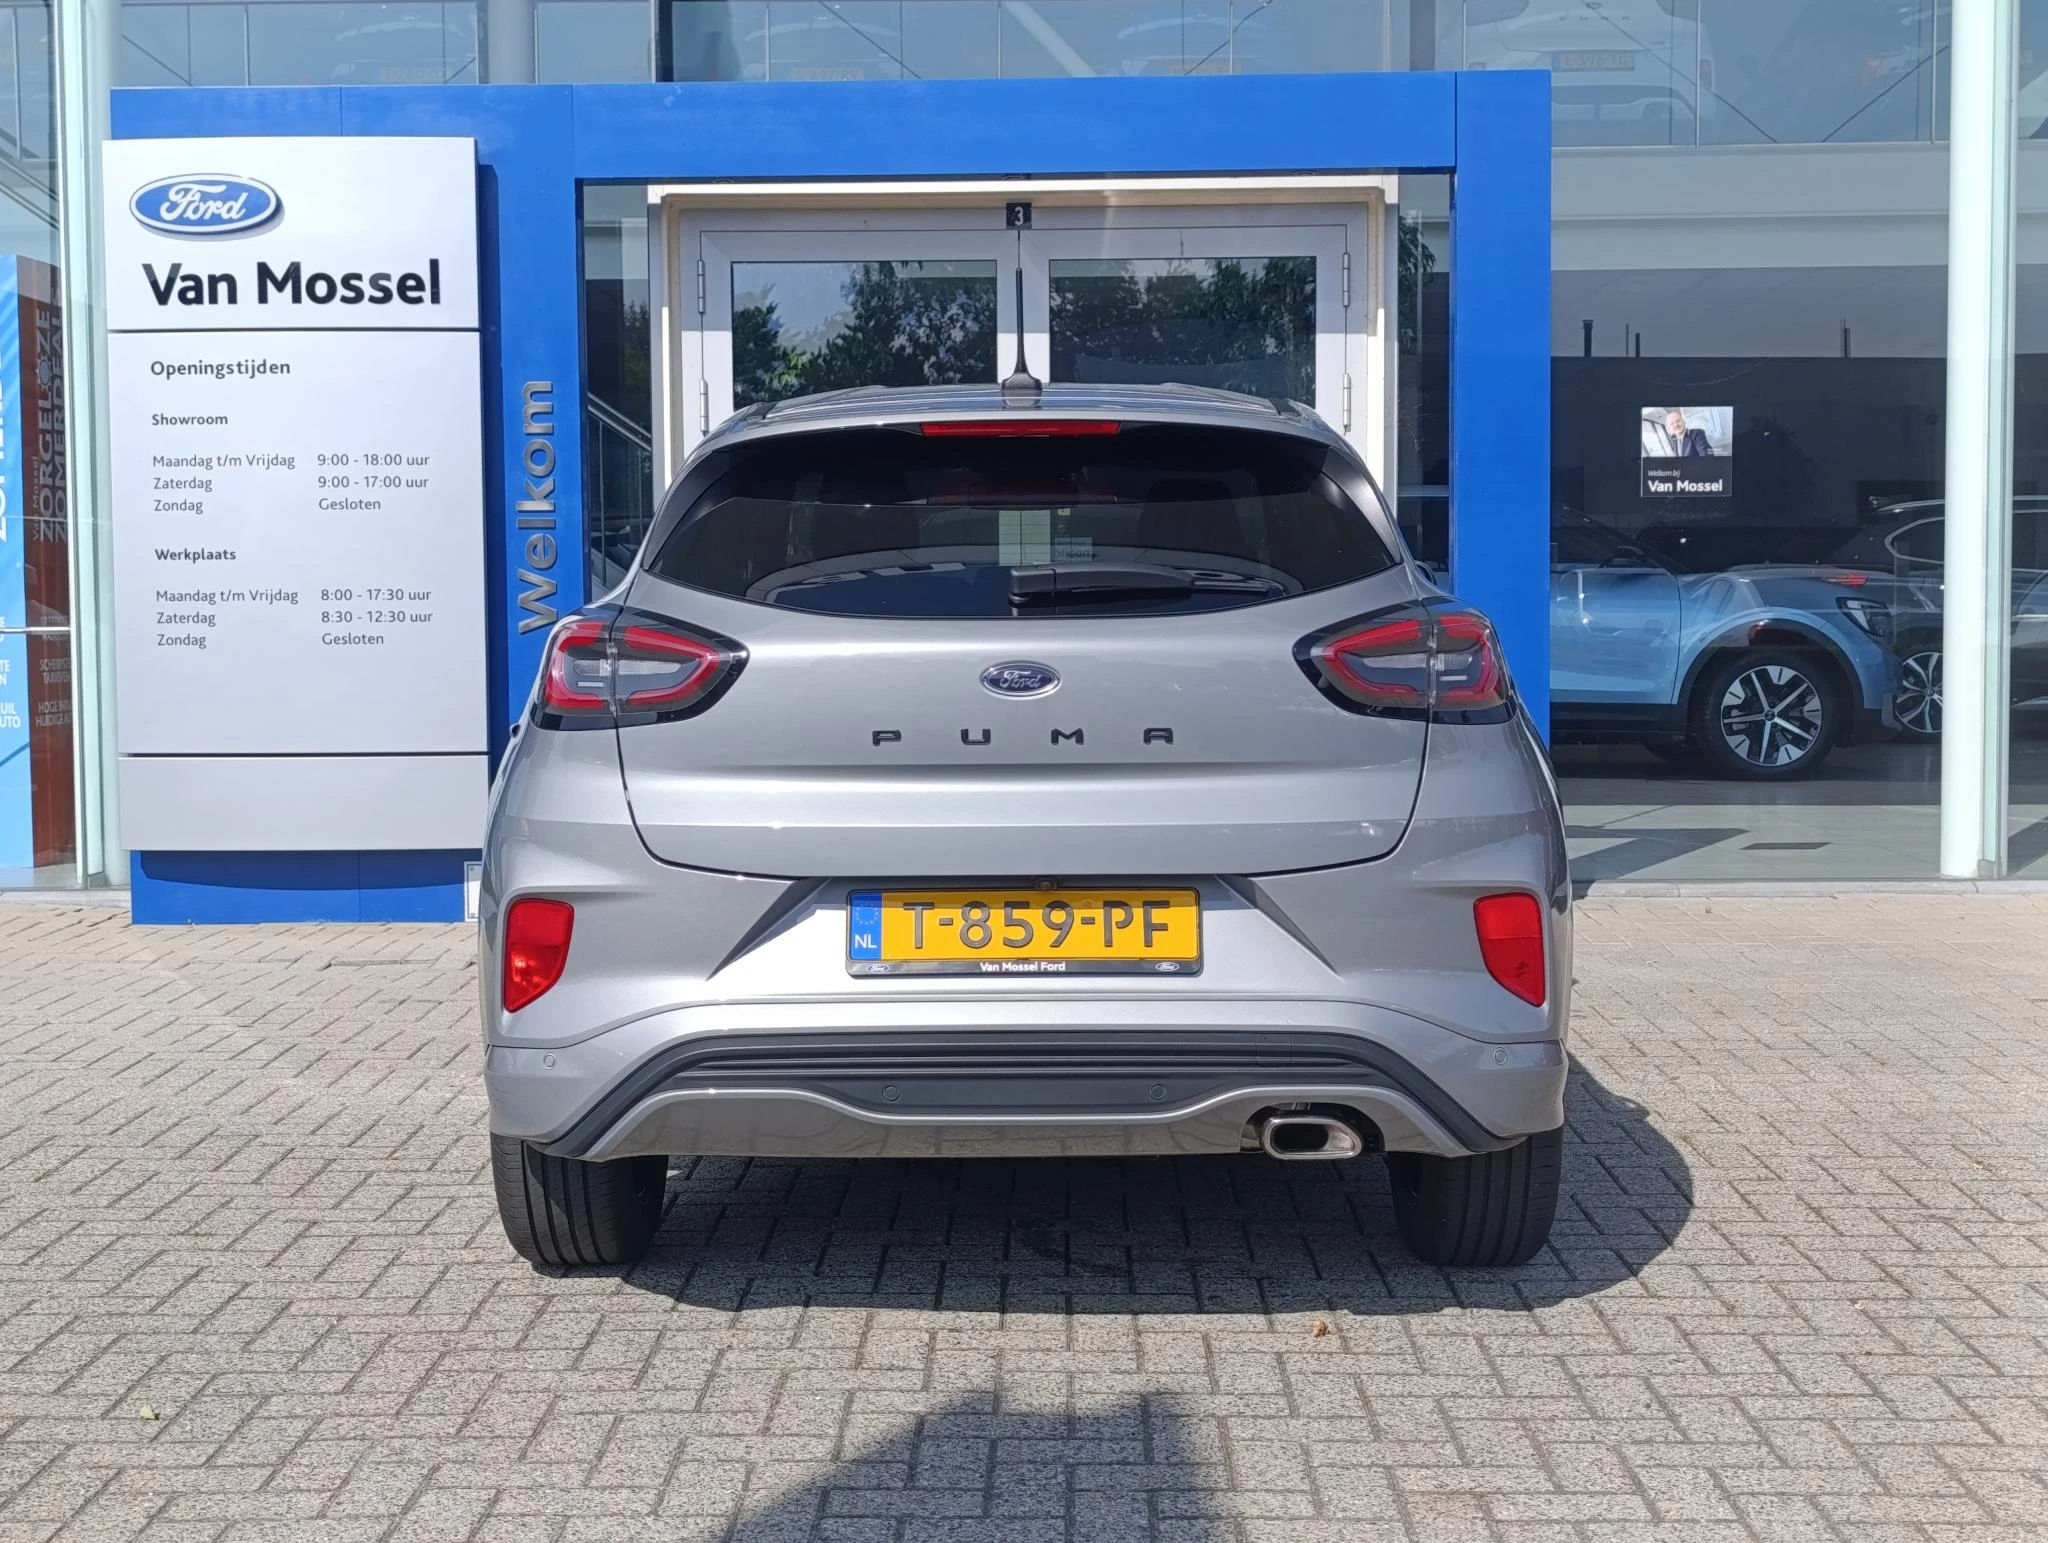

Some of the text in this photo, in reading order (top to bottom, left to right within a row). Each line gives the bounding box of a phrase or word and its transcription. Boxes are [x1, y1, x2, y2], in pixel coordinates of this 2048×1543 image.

[160, 183, 249, 221] Ford
[1014, 206, 1024, 226] 3
[142, 258, 441, 306] Van Mossel
[151, 359, 290, 380] Openingstijden
[152, 412, 229, 426] Showroom
[153, 454, 212, 470] Maandag
[215, 454, 243, 467] t/m
[246, 453, 296, 470] Vrijdag
[317, 453, 349, 467] 9:00
[363, 453, 402, 467] 18:00
[407, 456, 430, 467] uur
[32, 456, 40, 508] Mossel
[153, 475, 213, 492] Zaterdag
[317, 475, 350, 489] 9:00
[364, 475, 402, 489] 17:00
[406, 478, 430, 489] uur
[1647, 479, 1723, 492] Van Mossel
[154, 497, 382, 515] Zondag Gesloten
[515, 380, 557, 634] Welkom
[154, 547, 237, 564] Werkplaats
[156, 588, 216, 605] Maandag
[219, 588, 246, 602] t/m
[249, 588, 299, 605] Vrijdag
[320, 588, 352, 602] 8:00
[366, 588, 404, 602] 17:30
[408, 591, 432, 602] uur
[157, 610, 216, 627] Zaterdag
[321, 609, 353, 623] 8:30
[367, 610, 405, 623] 12:30
[409, 613, 433, 623] uur
[157, 632, 384, 650] Zondag Gesloten
[1000, 669, 1042, 688] Ford
[872, 728, 1174, 747] PUMA
[903, 900, 1171, 950] T-859-PF
[854, 934, 878, 949] NL
[980, 961, 1066, 972] Van Mossel Ford
